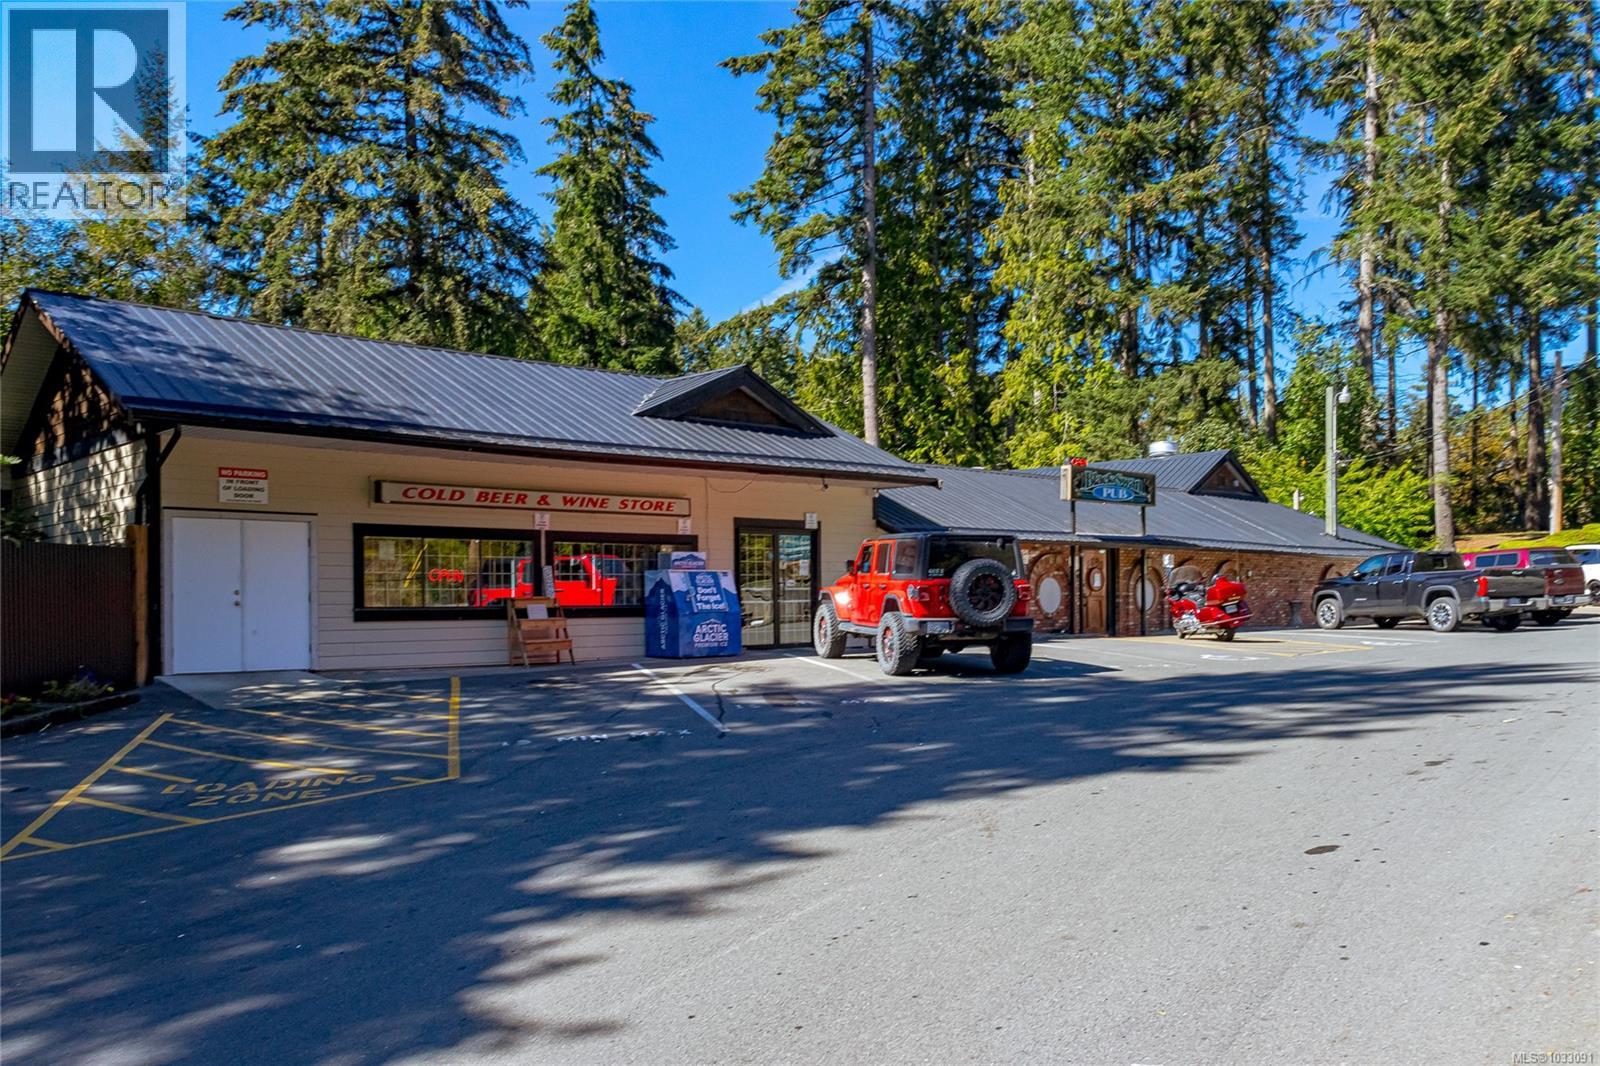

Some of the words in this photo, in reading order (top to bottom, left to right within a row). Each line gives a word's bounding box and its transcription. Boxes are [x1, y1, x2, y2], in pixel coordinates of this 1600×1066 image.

[233, 470, 266, 478] PARKING
[1102, 488, 1128, 499] PUB
[402, 487, 466, 501] COLD
[475, 490, 528, 504] BEER
[536, 494, 551, 506] &
[562, 495, 611, 509] WINE
[618, 499, 676, 512] STORE
[428, 568, 465, 583] OPEN
[697, 586, 717, 594] Don't
[696, 594, 721, 602] Forget
[696, 602, 711, 610] The
[696, 624, 727, 633] ARCTIC
[693, 632, 729, 642] GLACIER
[160, 774, 376, 795] LOADING
[188, 787, 331, 807] ZONE
